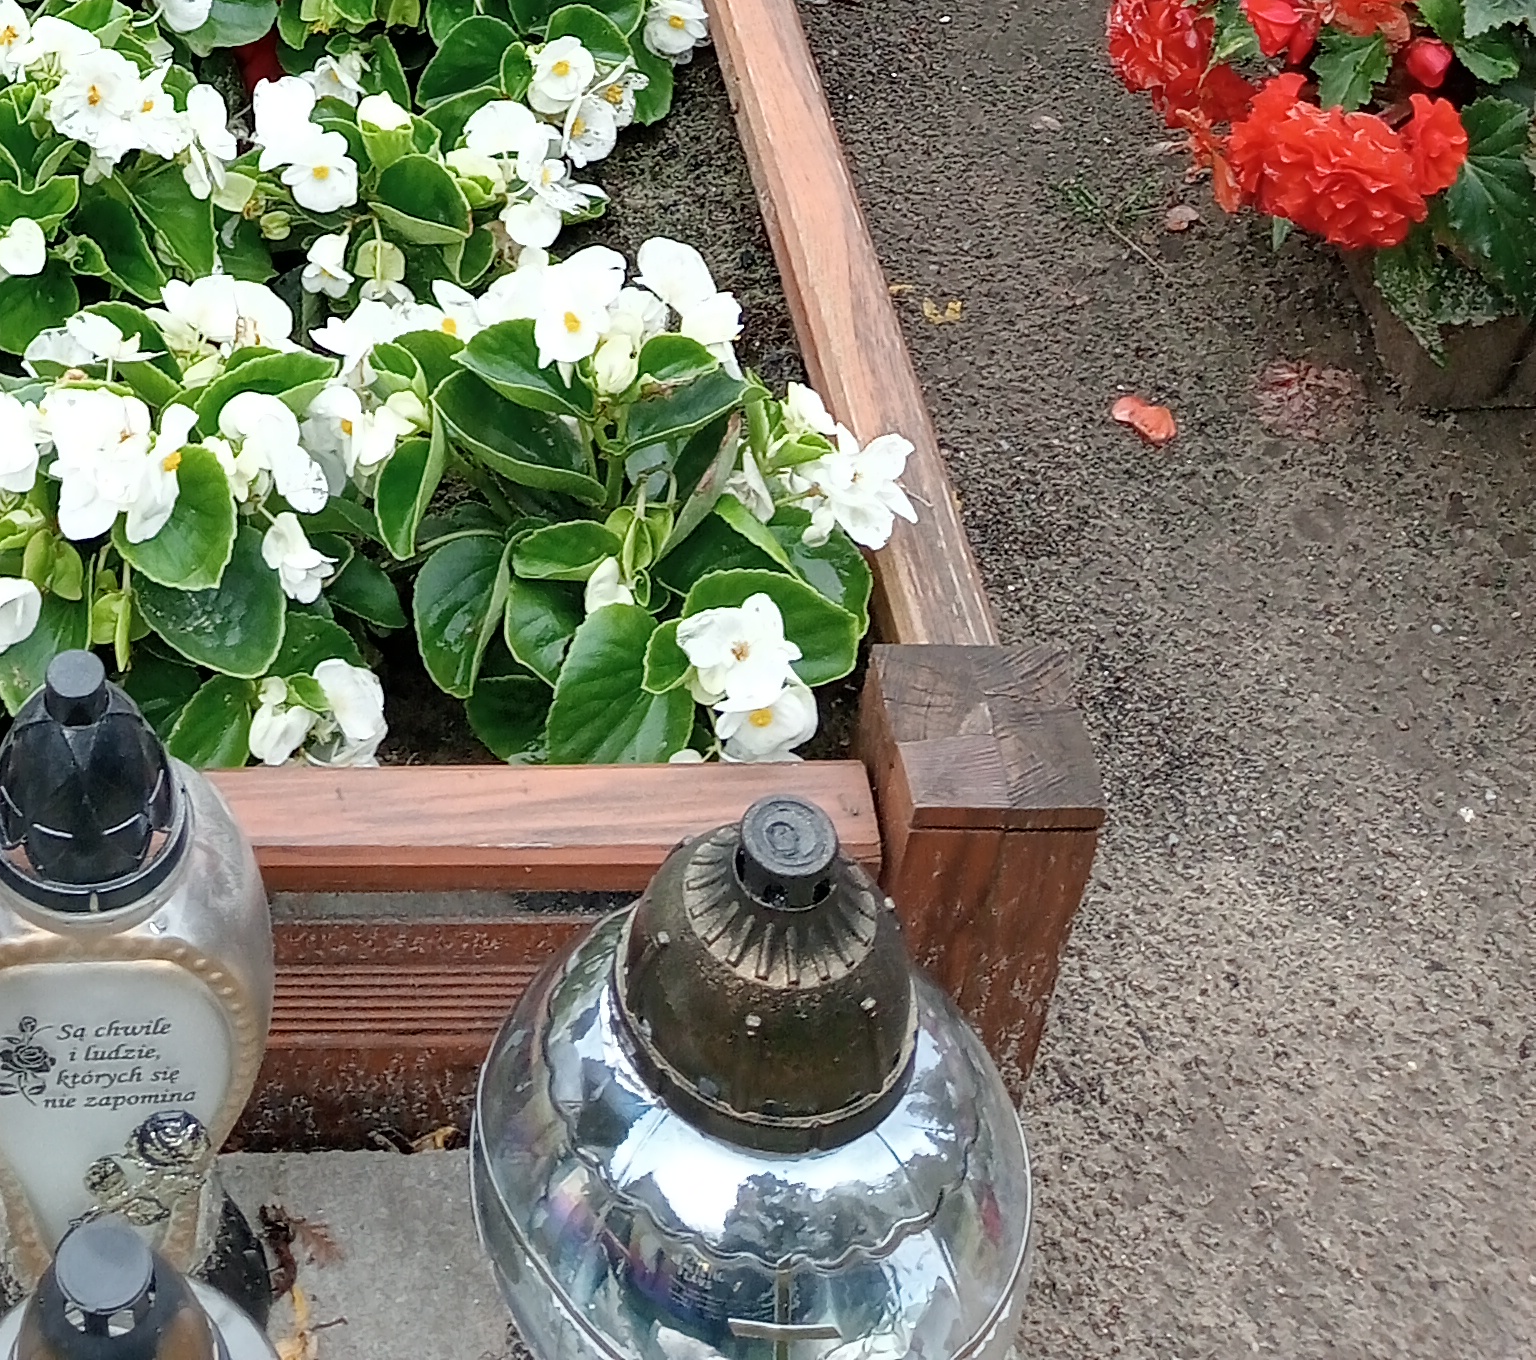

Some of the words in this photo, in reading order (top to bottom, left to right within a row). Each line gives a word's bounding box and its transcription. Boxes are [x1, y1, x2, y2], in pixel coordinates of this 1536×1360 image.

[55, 1023, 86, 1042] Są
[94, 1017, 172, 1038] chwile
[68, 1046, 78, 1063] i
[84, 1043, 162, 1062] ludzie,
[55, 1067, 143, 1089] których
[150, 1066, 181, 1084] się
[42, 1094, 76, 1109] nie
[83, 1088, 197, 1112] zapomina
